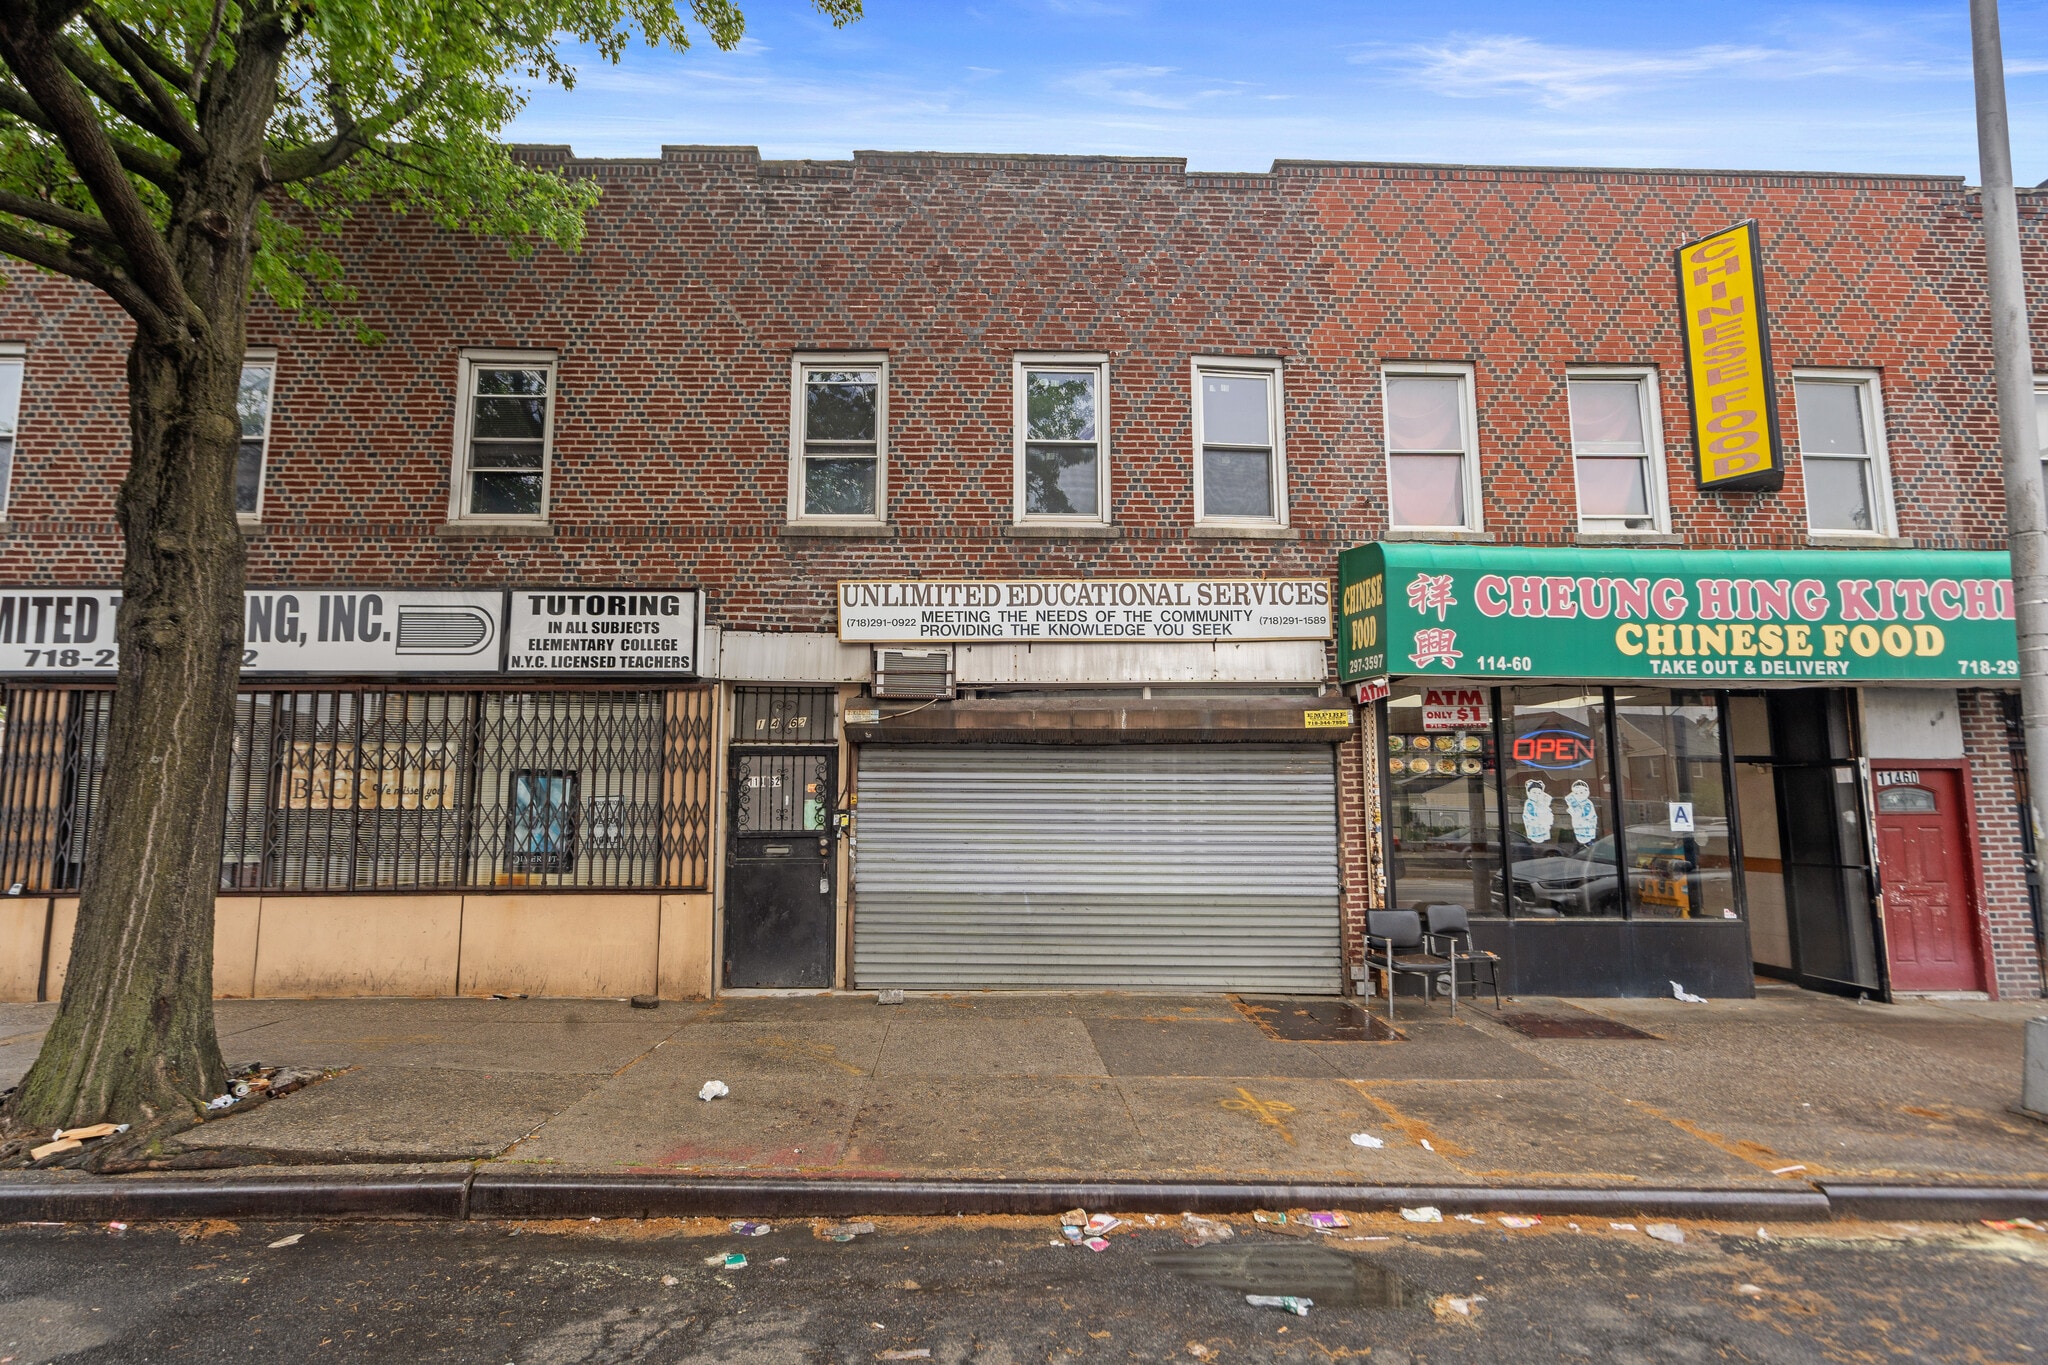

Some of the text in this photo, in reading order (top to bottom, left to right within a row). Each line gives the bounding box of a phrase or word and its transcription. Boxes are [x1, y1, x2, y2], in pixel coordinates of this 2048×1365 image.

[1690, 237, 1761, 477] CHINESE FOOD
[841, 582, 1329, 607] UNLIMITED EDUCATIONAL SERVICES
[1343, 573, 1383, 616] CHINESE
[1474, 574, 1689, 621] CHEUNG
[1696, 578, 1830, 621] HING
[528, 595, 680, 616] TUTORING
[317, 594, 391, 643] INC.
[846, 618, 917, 628] (718)291-0922
[922, 609, 1253, 623] MEETING THE NEEDS OF THE COMMUNITY
[1259, 616, 1327, 626] (718)291-1589
[548, 621, 660, 634] IN ALL SUBJECTS
[920, 623, 1233, 637] PROVIDING THE KNOWLEDGE YOU SEEK
[1352, 615, 1377, 651] FOOD
[528, 638, 678, 651] ELEMENTARY COLLEGE
[1615, 622, 1945, 657] CHINESE FOOD
[511, 655, 690, 668] N.Y.C. LICENSED TEACHERS
[1349, 654, 1384, 674] 297-3597
[1477, 656, 1532, 672] 114-60
[1649, 660, 1850, 675] TAKE OUT & DELIVERY
[1958, 660, 2020, 675] 718-29
[1360, 683, 1388, 703] ATM
[1424, 690, 1484, 706] ATM
[1426, 706, 1481, 721] ONLY $1
[1512, 738, 1595, 761] OPEN
[1879, 771, 1918, 785] 11460
[292, 778, 369, 800] BACK
[1674, 806, 1689, 823] A
